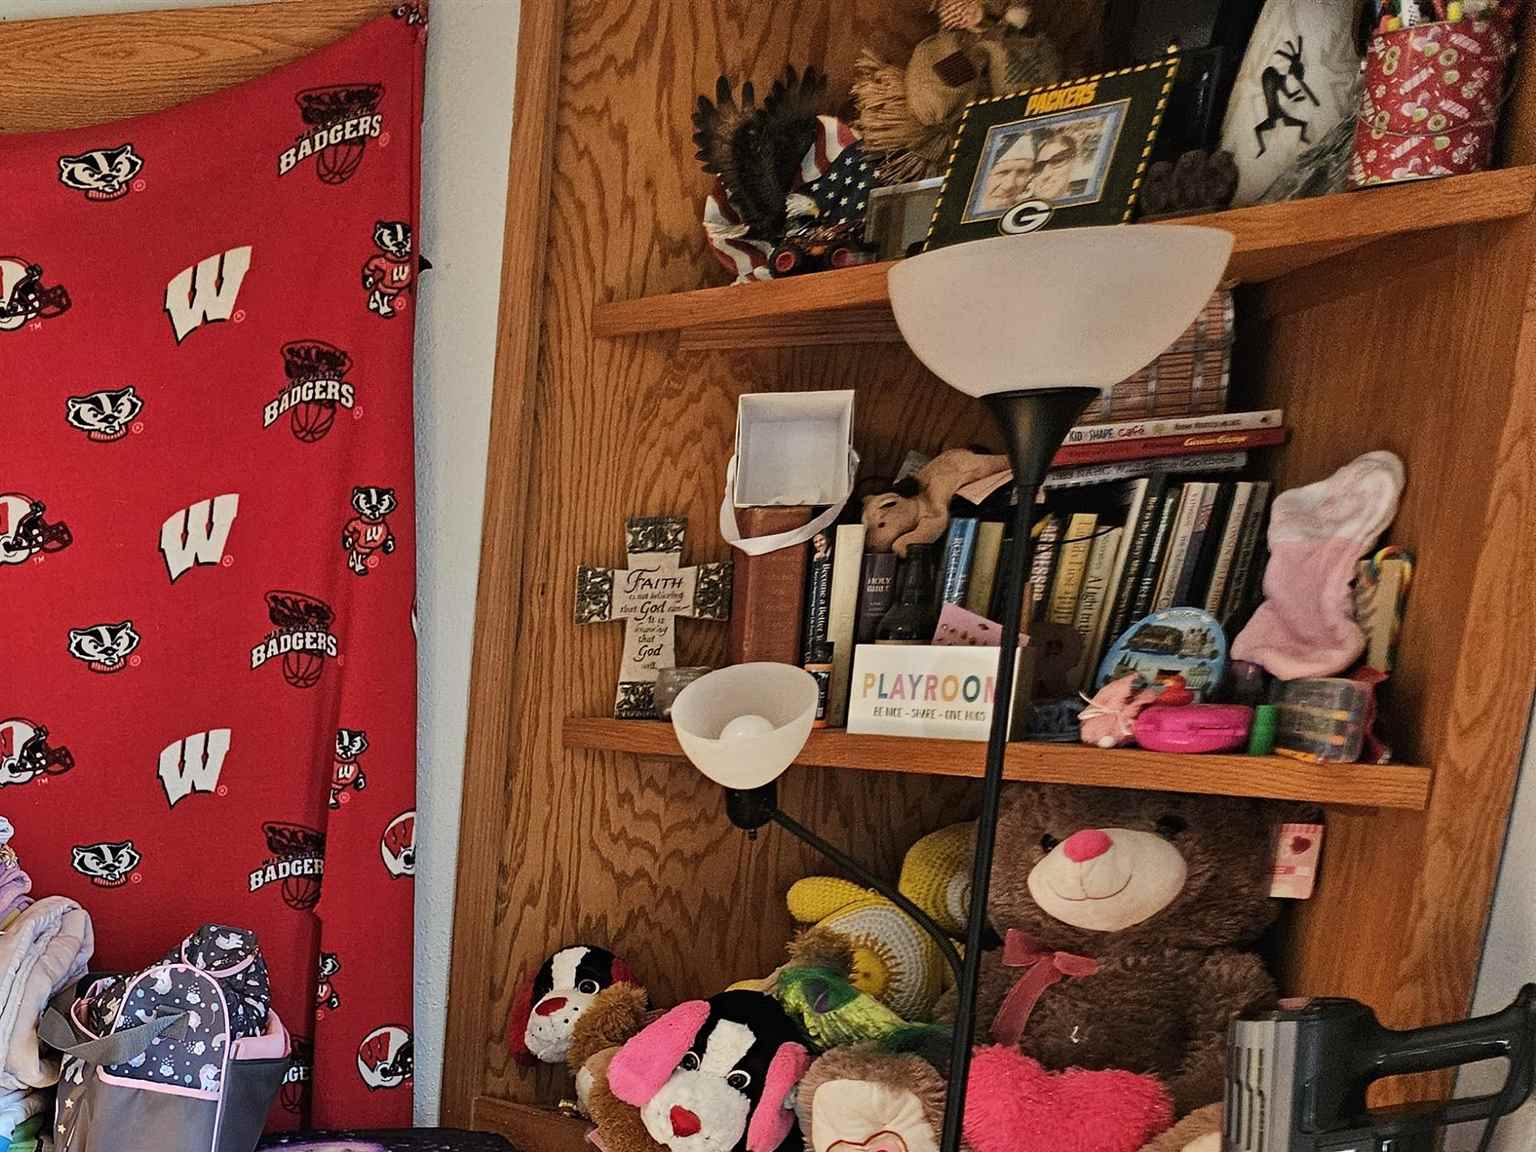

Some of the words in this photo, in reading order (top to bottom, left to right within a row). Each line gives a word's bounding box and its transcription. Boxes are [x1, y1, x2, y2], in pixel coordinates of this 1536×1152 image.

[1023, 81, 1100, 117] PACKERS
[279, 113, 383, 176] BADGERS
[165, 245, 252, 342] W
[264, 379, 355, 428] BADGERS
[160, 493, 239, 583] W
[624, 565, 684, 593] FAITH
[634, 600, 667, 621] God
[250, 631, 337, 670] BADGERS
[632, 643, 664, 662] God
[159, 729, 231, 806] W
[249, 858, 325, 891] BADGER
